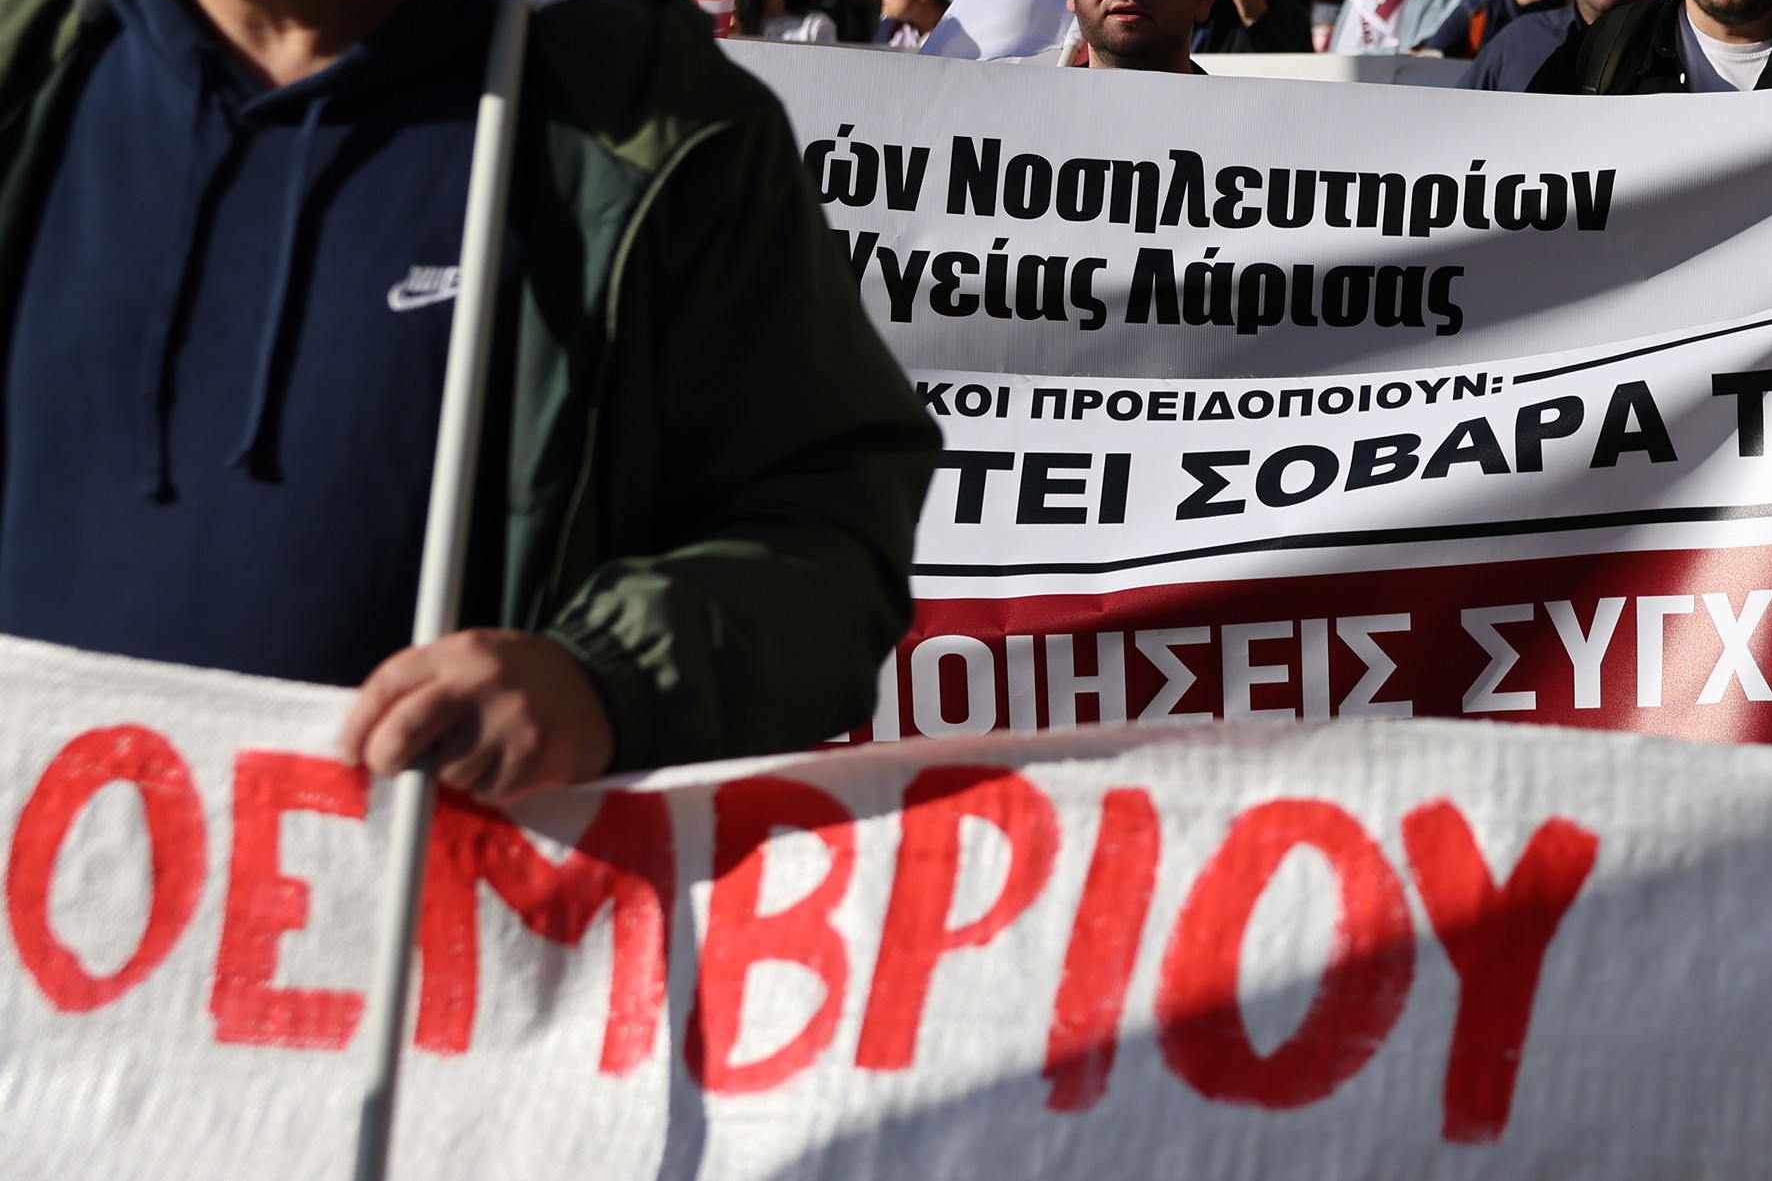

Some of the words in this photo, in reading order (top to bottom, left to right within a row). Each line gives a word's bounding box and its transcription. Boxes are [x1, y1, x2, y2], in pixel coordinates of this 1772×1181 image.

[947, 136, 1616, 236] Νοσηλευτηρίων
[1125, 247, 1464, 335] Λάρισας
[1030, 372, 1503, 421] ΠΡΟΕΙΔΟΠΟΙΟΥΝ:
[942, 450, 1131, 525] ΤΕΙ
[1175, 380, 1678, 522] ΣΟΒΑΡΑ
[6, 723, 1600, 1145] ΟΕΜΒΡΙΟΥ
